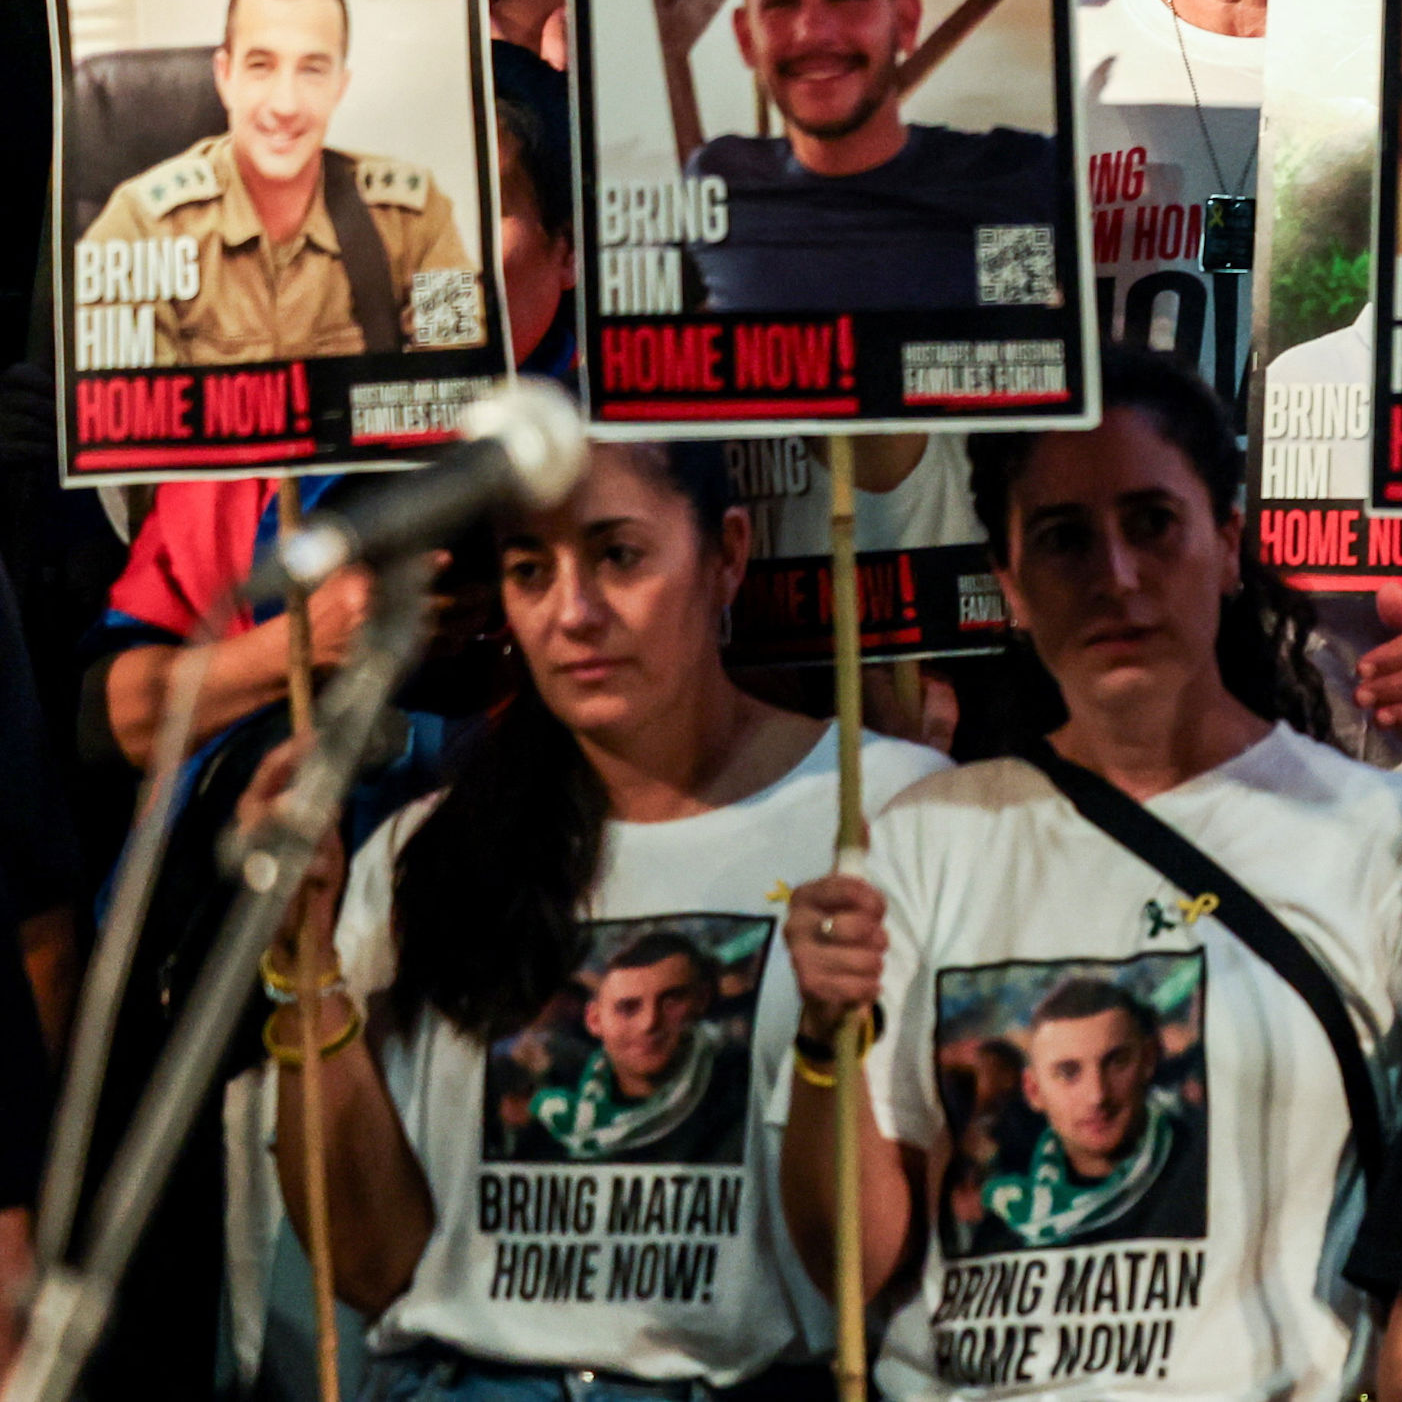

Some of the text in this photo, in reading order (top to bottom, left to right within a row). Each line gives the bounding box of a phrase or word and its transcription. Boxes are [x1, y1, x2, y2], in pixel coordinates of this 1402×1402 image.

[601, 175, 729, 248] BRING
[600, 246, 683, 316] HIM
[602, 314, 856, 392] HOME NOW!
[1265, 383, 1370, 440] BRING
[1261, 443, 1332, 500] HIM
[1260, 509, 1360, 566] HOME
[478, 1173, 743, 1237] BRING MATAN
[489, 1241, 719, 1304] HOME NOW!
[932, 1249, 1206, 1326] BRING MATAN
[1050, 1319, 1174, 1381] NOW!
